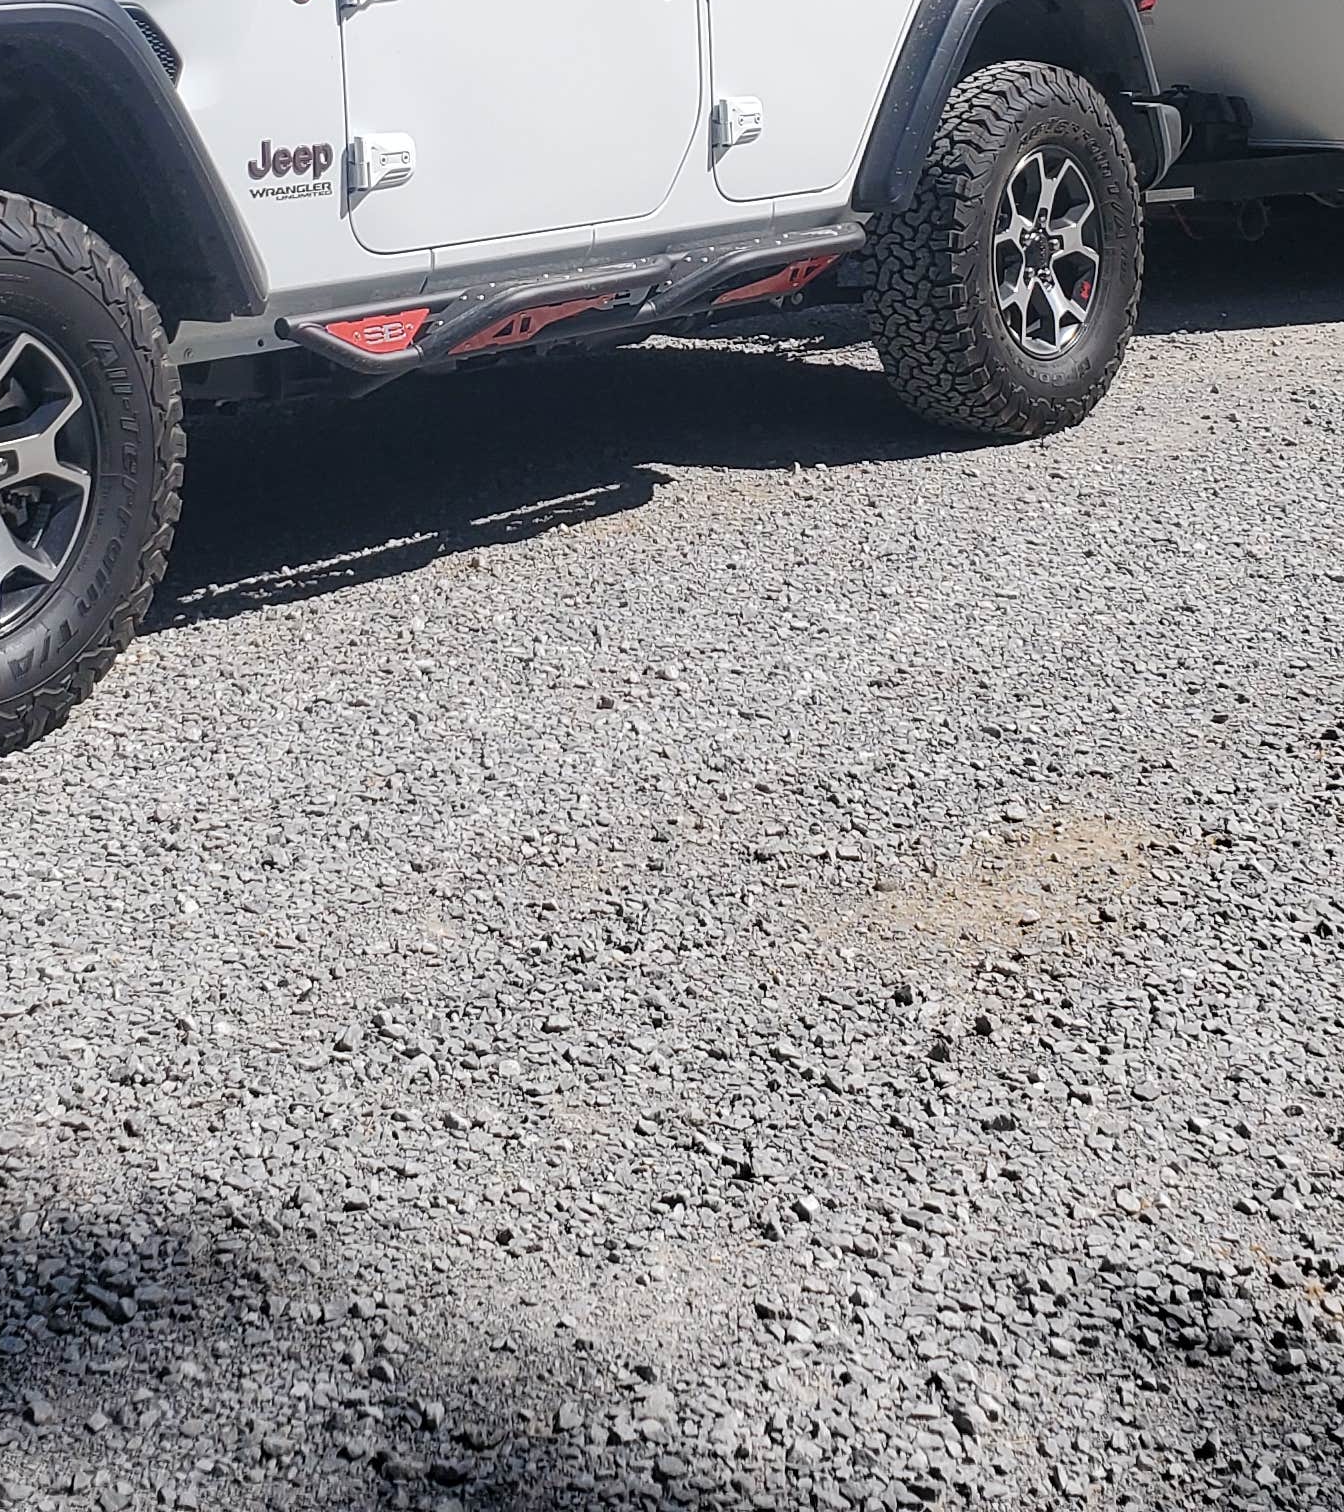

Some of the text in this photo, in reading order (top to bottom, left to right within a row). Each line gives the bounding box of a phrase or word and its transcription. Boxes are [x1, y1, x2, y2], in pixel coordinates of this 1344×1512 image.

[247, 139, 334, 181] Jeep
[249, 181, 333, 199] WRANGLER
[275, 190, 333, 201] UNLIMITED
